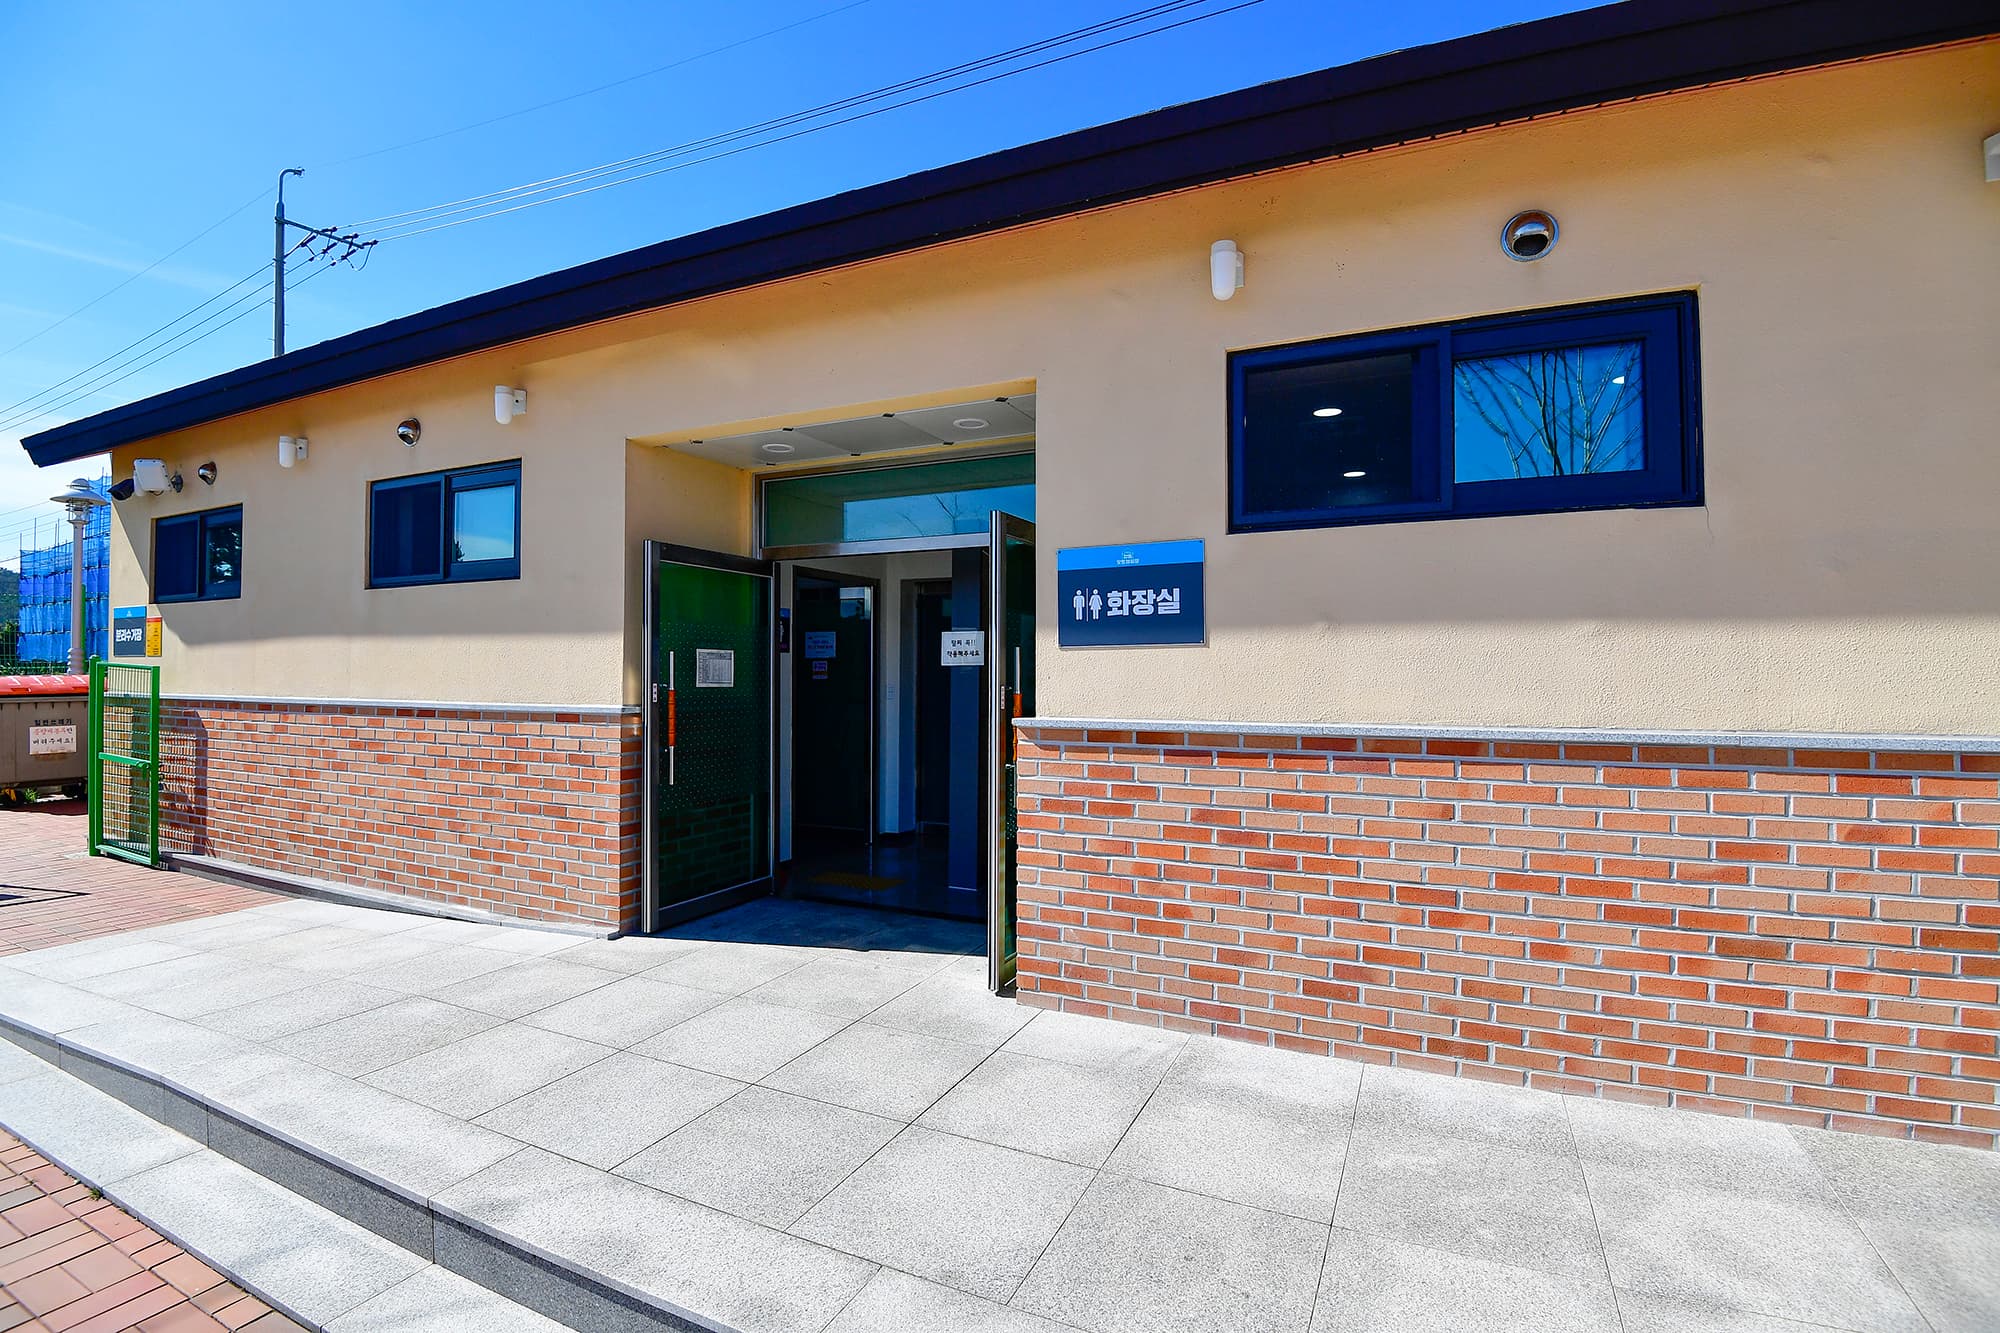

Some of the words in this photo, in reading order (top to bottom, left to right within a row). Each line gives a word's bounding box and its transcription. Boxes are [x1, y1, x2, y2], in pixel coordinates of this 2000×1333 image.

[1106, 587, 1181, 617] 화장실
[115, 628, 142, 642] 분리수거장
[946, 650, 980, 658] 착용해주세요
